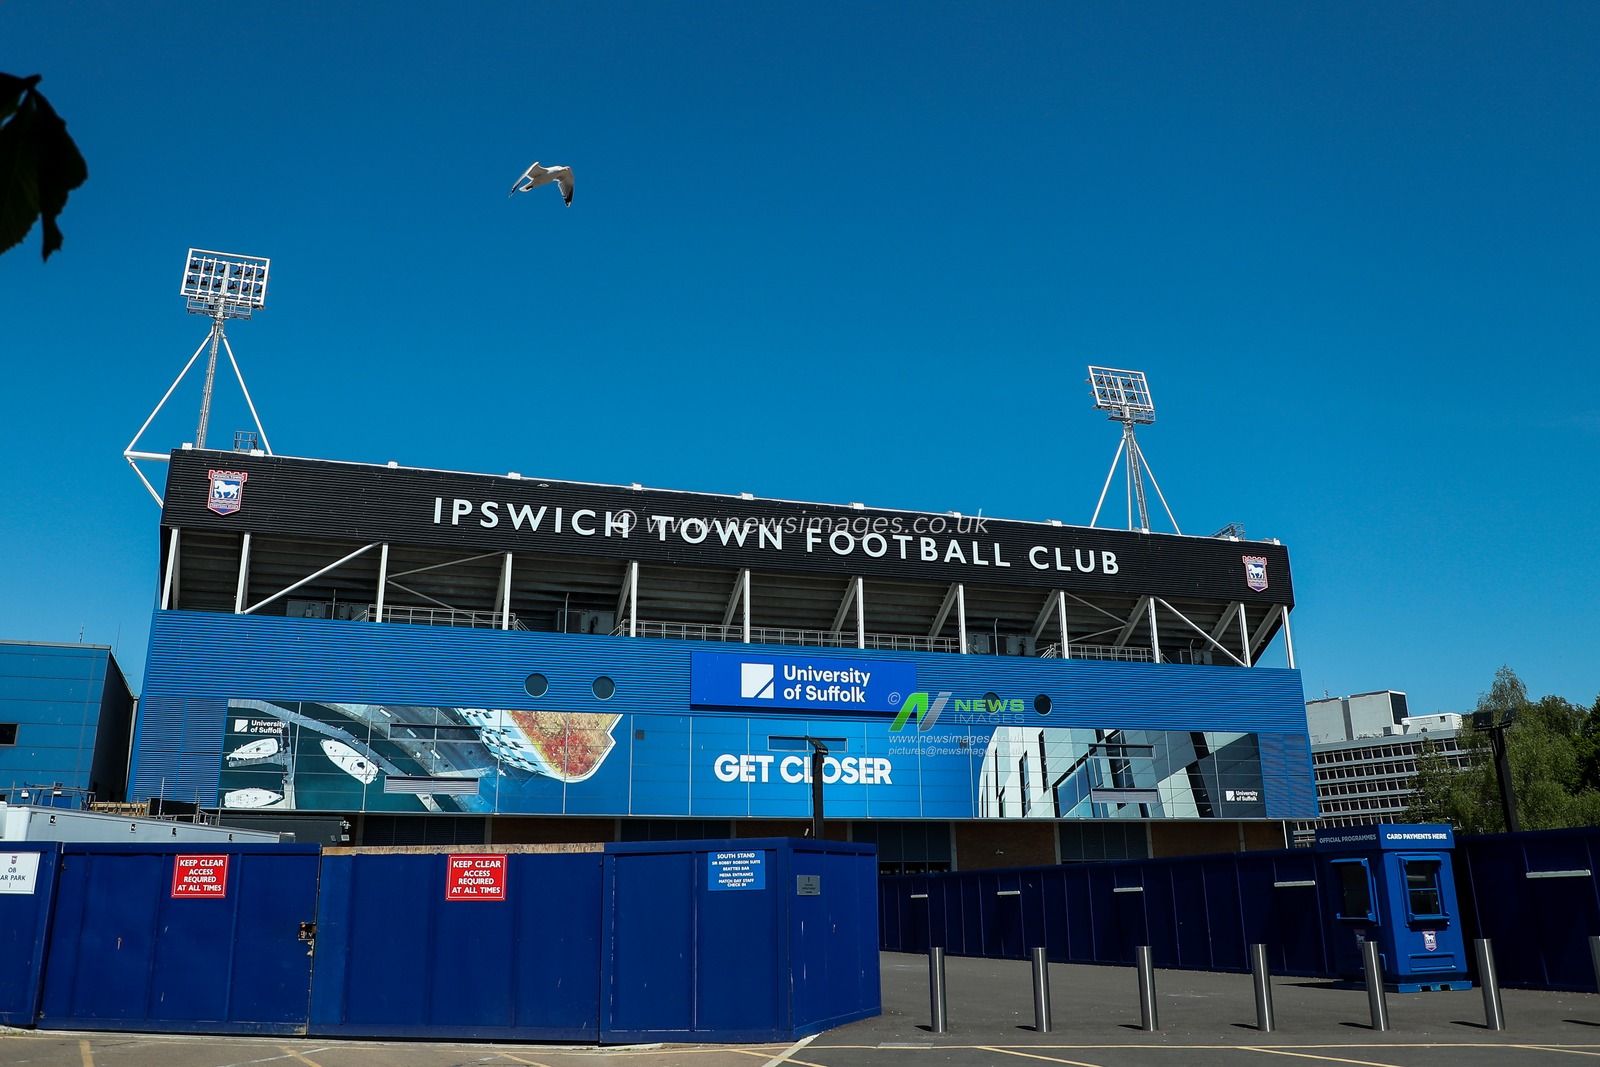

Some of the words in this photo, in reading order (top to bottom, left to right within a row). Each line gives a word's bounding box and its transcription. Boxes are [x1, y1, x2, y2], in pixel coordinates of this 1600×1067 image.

[433, 497, 629, 538] IPSWICH
[651, 515, 783, 550] TOWN
[806, 528, 1011, 567] FOOTBALL
[1029, 546, 1119, 575] CLUB
[783, 664, 871, 687] University
[783, 684, 802, 700] of
[805, 685, 866, 703] Suffolk
[251, 720, 286, 728] University
[713, 754, 774, 783] GET
[779, 755, 893, 785] CLOSER
[1319, 836, 1341, 844] OFFICIAL
[1341, 834, 1377, 843] PROGRAMMES
[180, 859, 198, 867] KEEP
[200, 859, 224, 867] CLEAR
[453, 860, 473, 868] KEEP
[475, 860, 501, 868] CLEAR
